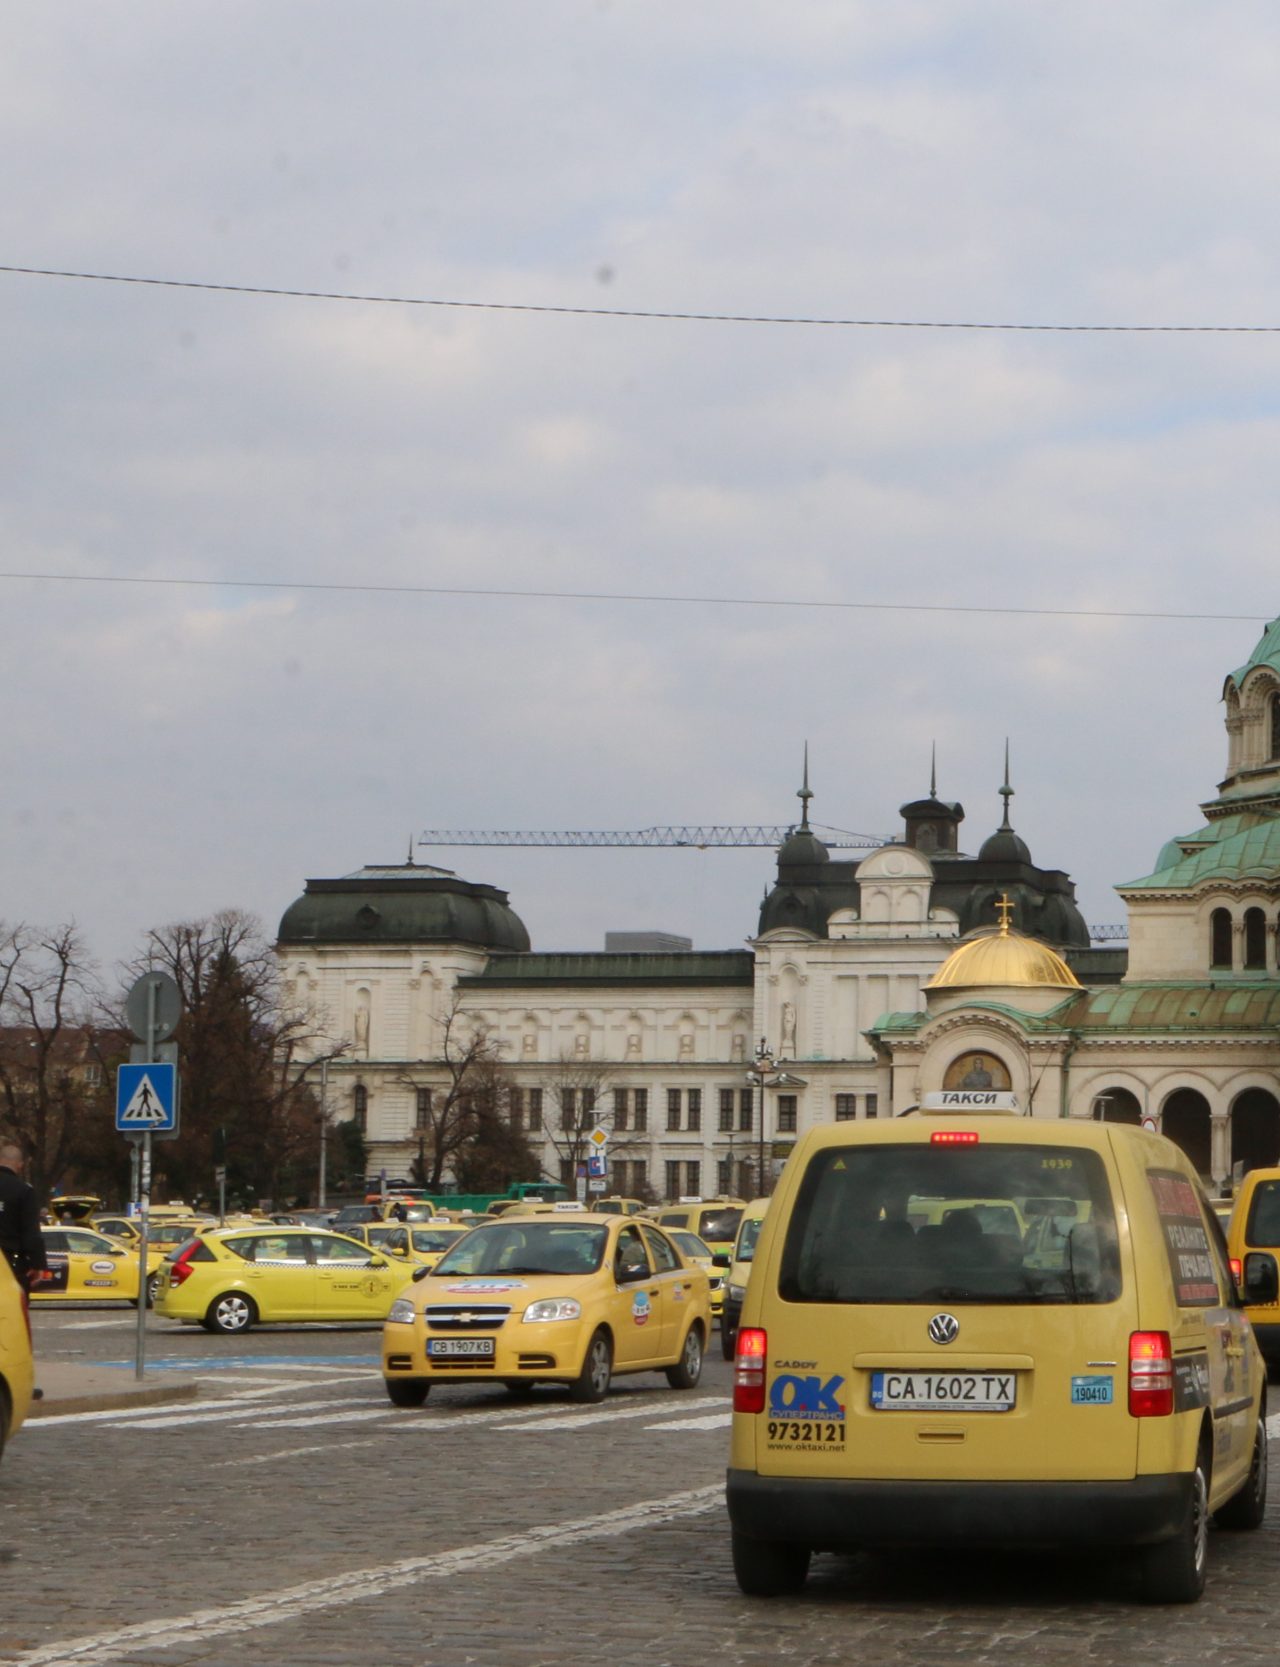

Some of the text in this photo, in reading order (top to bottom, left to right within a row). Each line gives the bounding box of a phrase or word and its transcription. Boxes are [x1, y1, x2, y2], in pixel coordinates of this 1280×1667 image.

[941, 1092, 997, 1105] ТАКСИ
[451, 1341, 475, 1353] 1907
[886, 1376, 1011, 1401] CA 1602 TX
[1075, 1387, 1108, 1401] 190410
[767, 1422, 846, 1442] 9732121
[767, 1443, 846, 1452] www.oktaxi.net
